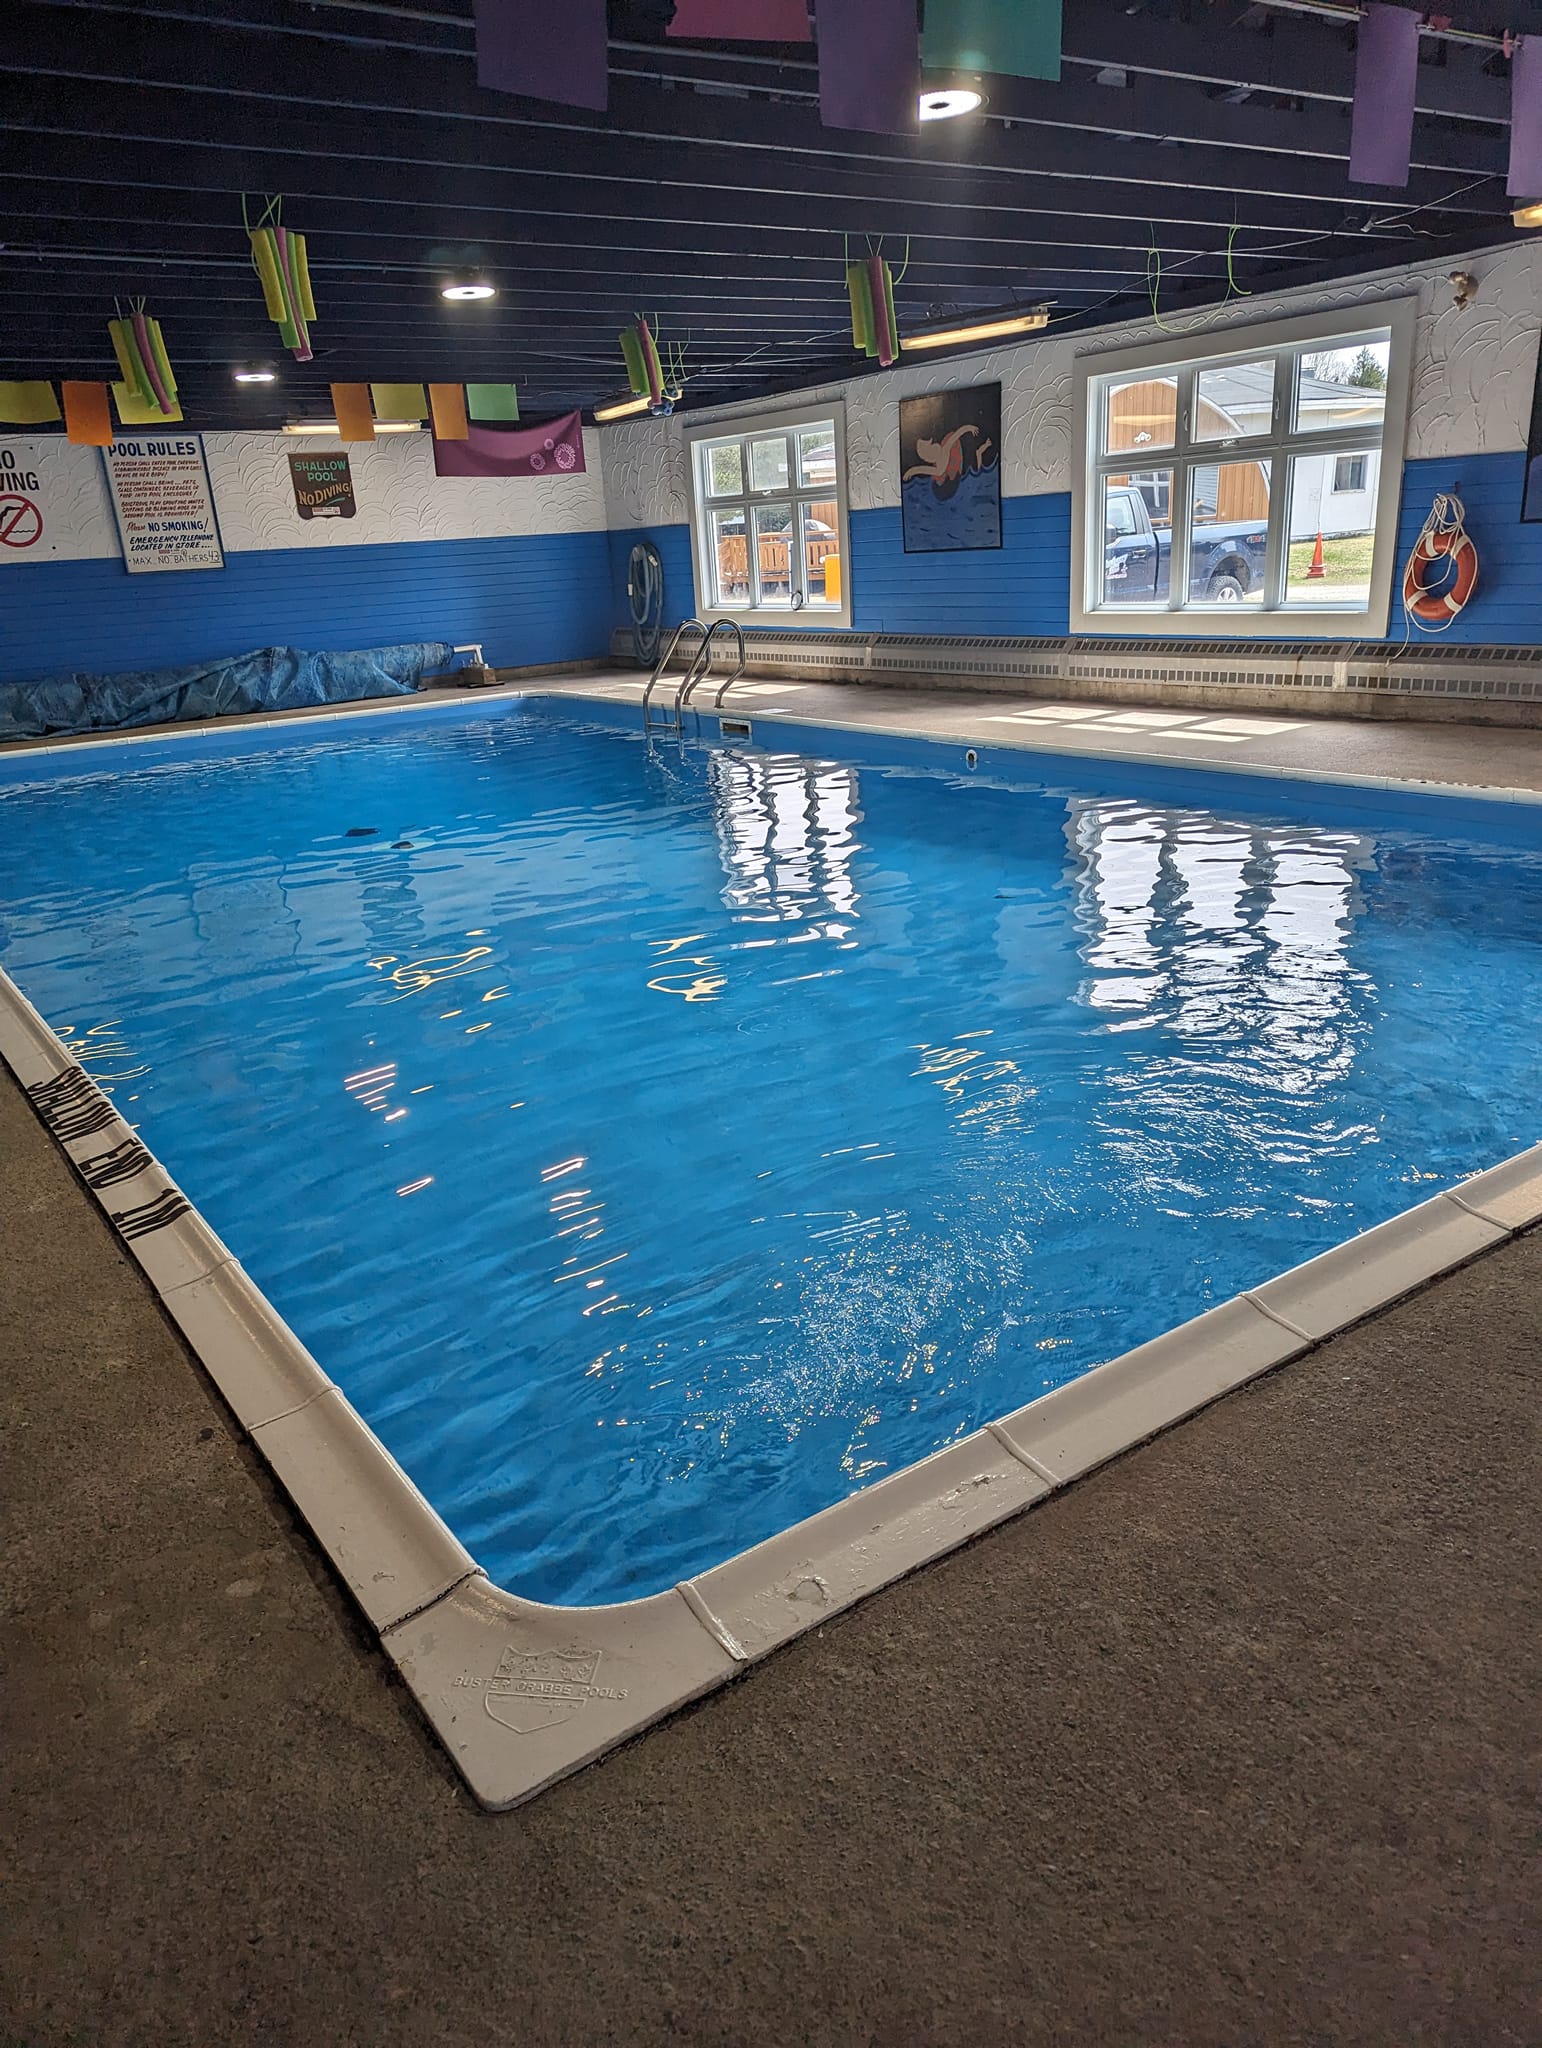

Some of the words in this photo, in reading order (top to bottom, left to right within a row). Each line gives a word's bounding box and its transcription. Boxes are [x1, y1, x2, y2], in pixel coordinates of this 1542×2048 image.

[108, 442, 146, 457] POOL
[146, 442, 196, 456] RULES
[0, 450, 15, 469] O
[294, 461, 346, 471] SHALLOW
[307, 472, 337, 481] POOL
[126, 521, 145, 533] Please
[148, 522, 160, 532] NO
[162, 518, 208, 532] SMOKING!
[130, 535, 179, 544] EMERGENCY
[131, 543, 164, 551] LOCATED
[174, 553, 208, 563] BATHERS
[209, 551, 220, 560] 43
[28, 1066, 120, 1142] SHALLOW
[78, 1137, 154, 1190] END
[452, 1674, 511, 1689] BUSTER
[580, 1686, 630, 1700] POOLS
